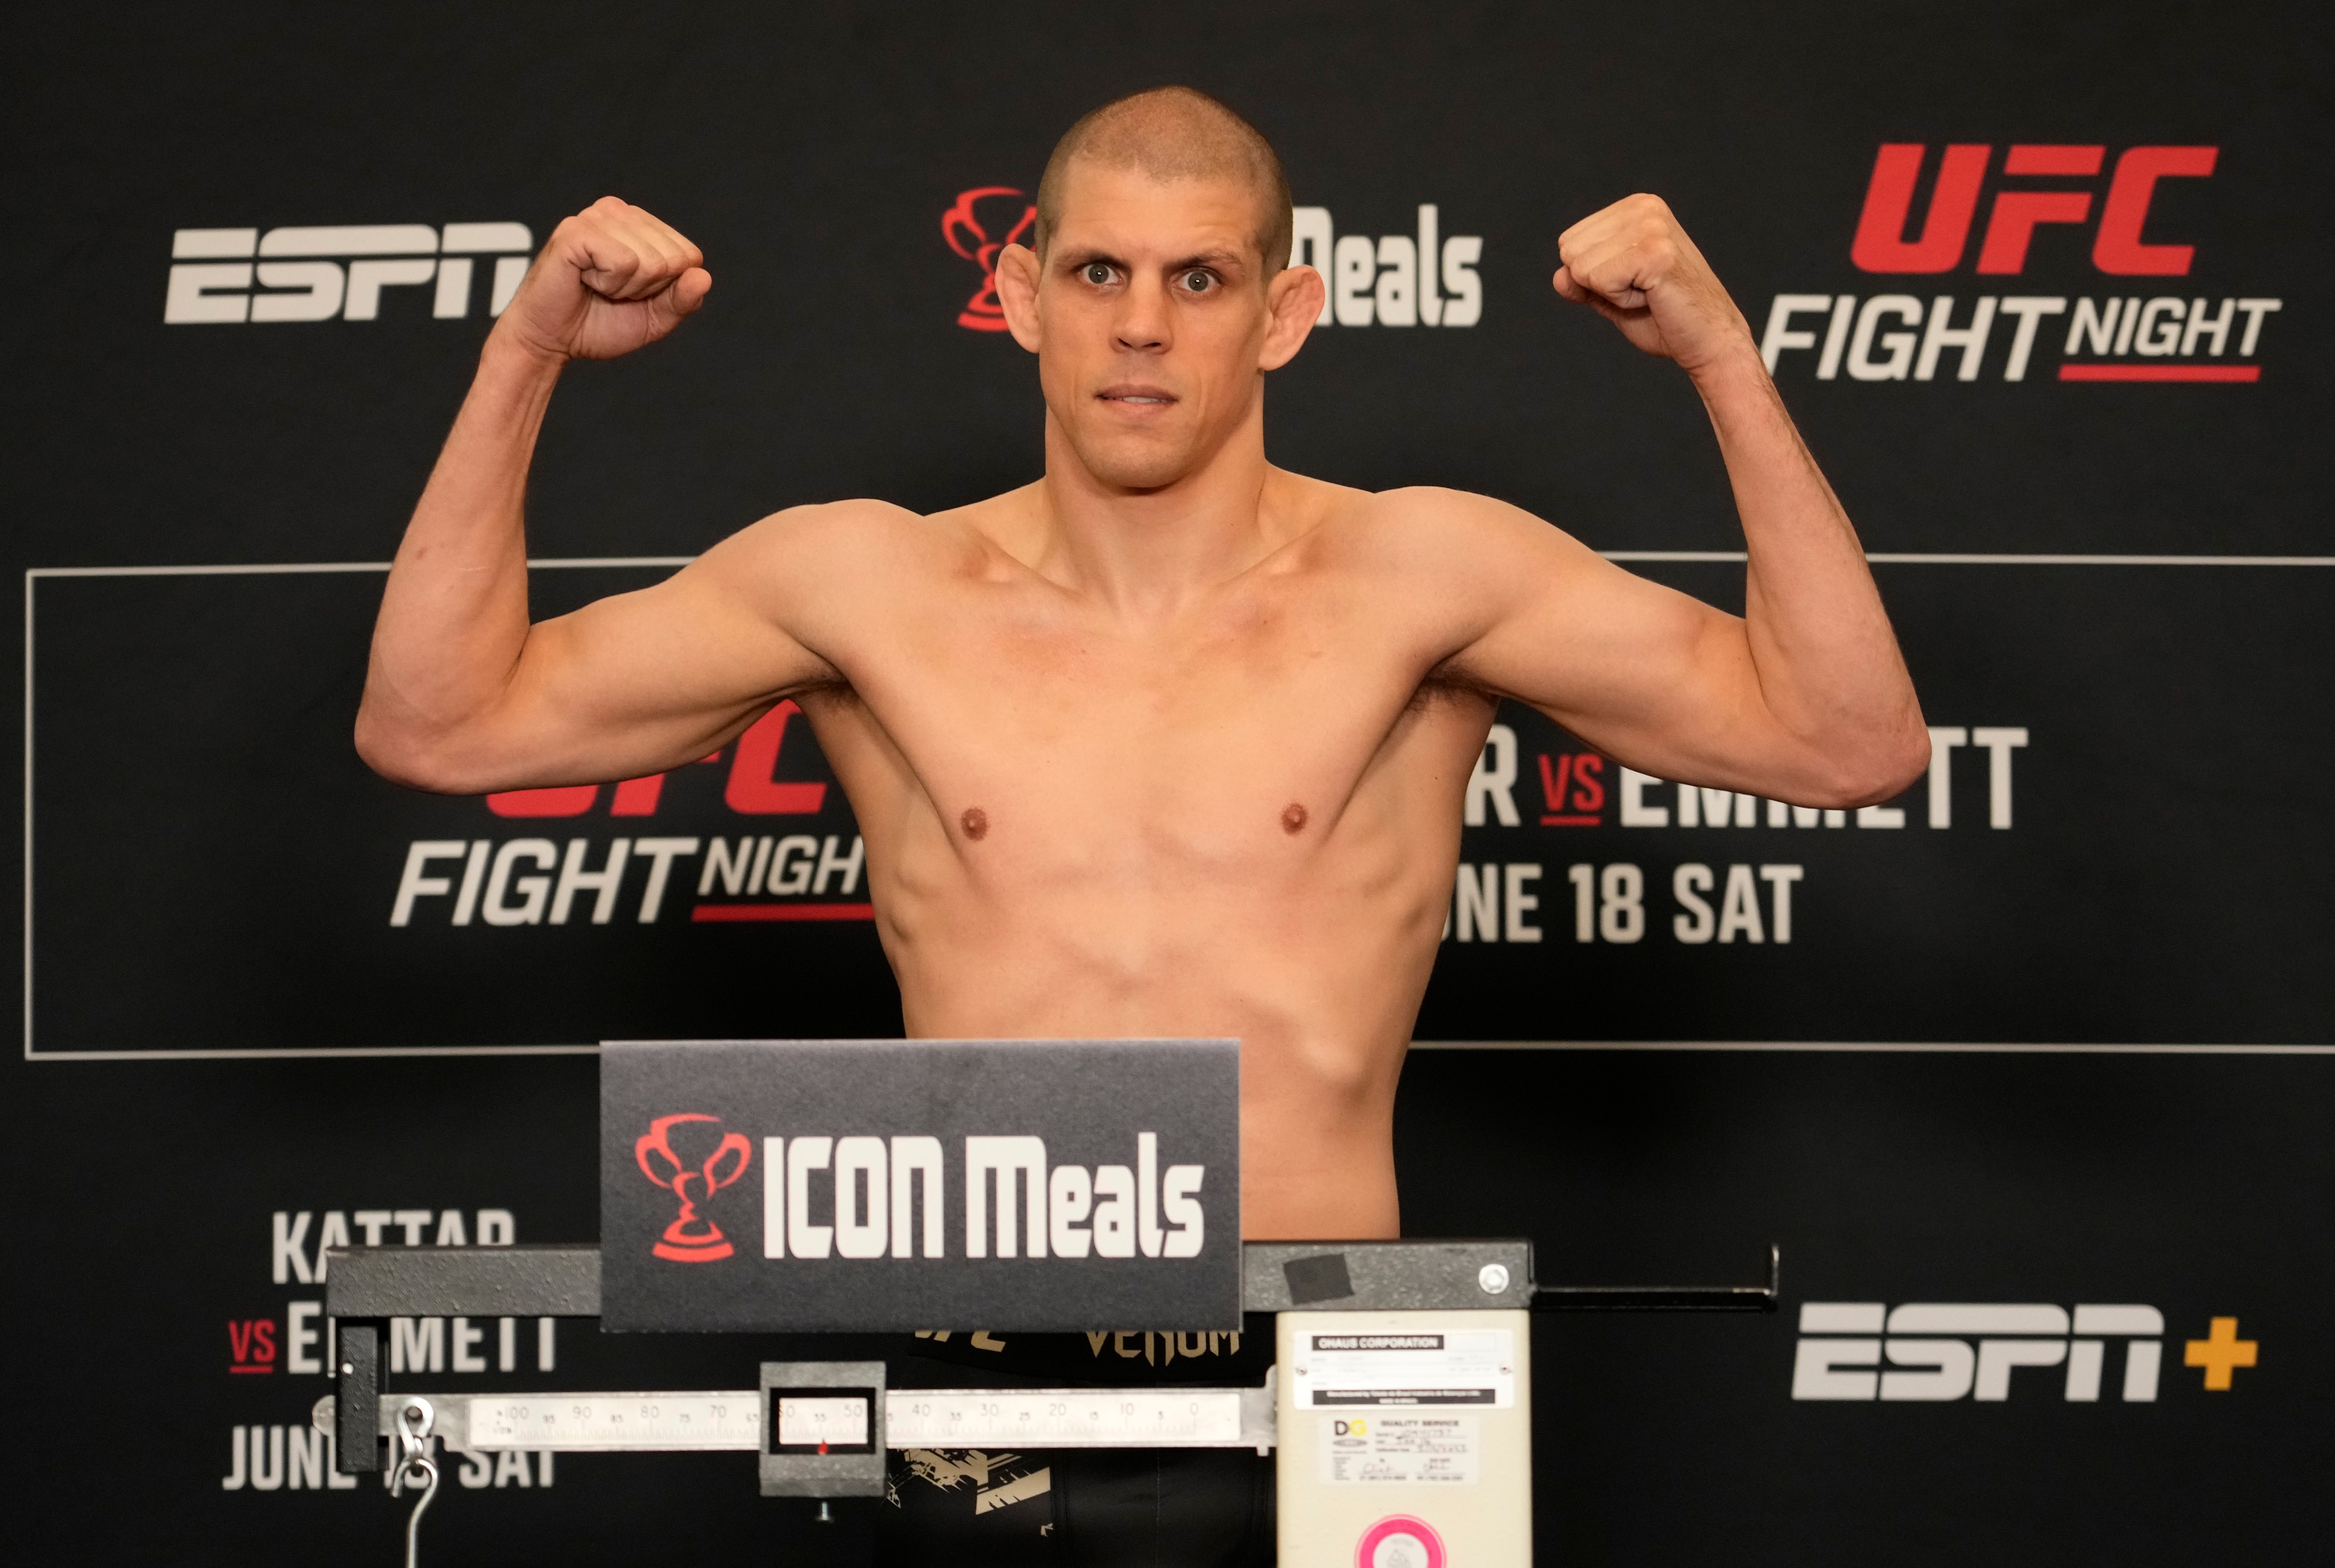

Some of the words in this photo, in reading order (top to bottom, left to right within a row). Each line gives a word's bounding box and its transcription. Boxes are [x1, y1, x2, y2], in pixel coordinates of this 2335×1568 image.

[1850, 143, 2219, 276] UFC
[165, 222, 532, 324] ESPN
[1761, 294, 2066, 381] FIGHT
[2064, 297, 2282, 357] NIGHT
[1539, 753, 1605, 814] VS
[390, 838, 699, 926] FIGHT
[697, 835, 866, 896] NIGH
[1569, 863, 1645, 944] 18
[1674, 863, 1804, 944] SAT
[763, 1136, 944, 1259] ICON
[965, 1131, 1205, 1259] Meals
[229, 1319, 276, 1363] VS
[1319, 1337, 1358, 1349] OHAUS
[1359, 1336, 1439, 1349] CORPORATION
[572, 1405, 591, 1419] 90
[640, 1405, 660, 1419] 80
[710, 1405, 727, 1418] 70
[844, 1404, 863, 1417] 50
[912, 1404, 930, 1417] 40
[980, 1403, 998, 1417] 30
[1049, 1403, 1066, 1416] 20
[1121, 1403, 1134, 1416] 10
